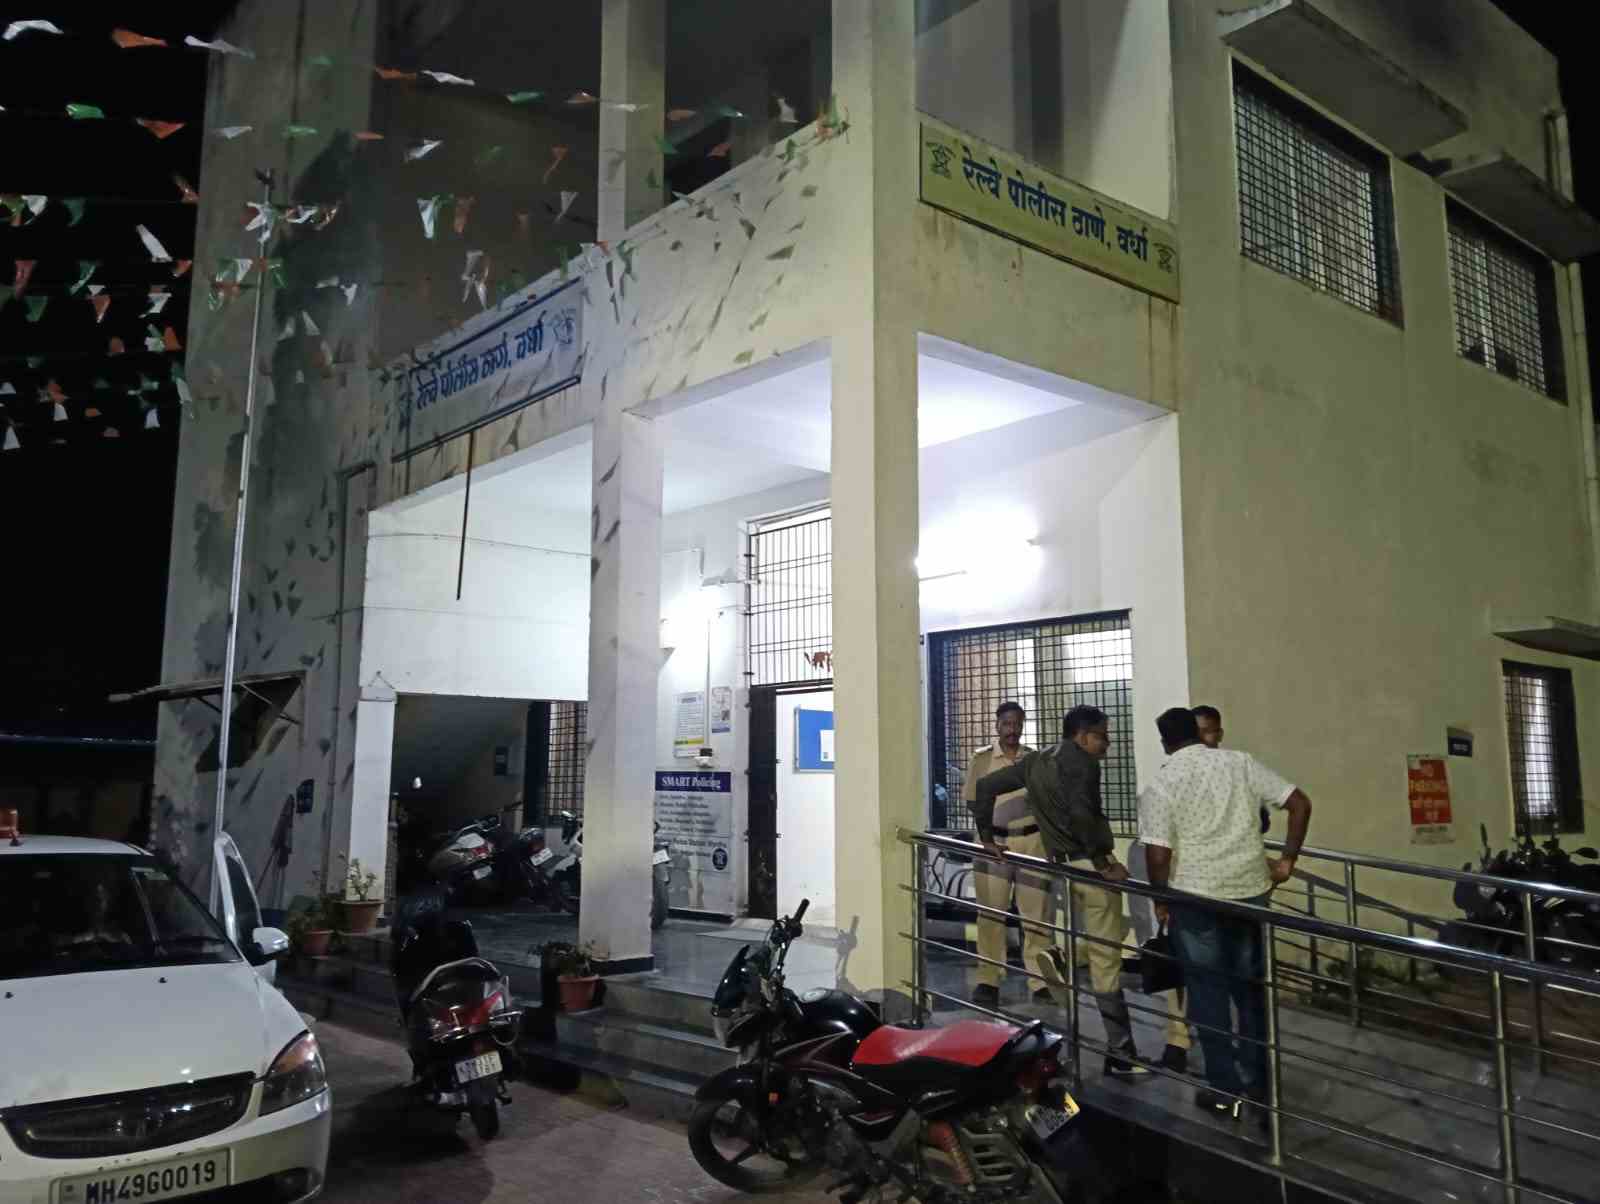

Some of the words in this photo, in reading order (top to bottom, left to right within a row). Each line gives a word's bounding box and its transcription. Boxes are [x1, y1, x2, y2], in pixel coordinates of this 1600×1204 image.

[962, 145, 1001, 198] रेल्वे
[1007, 170, 1067, 227] पोलीस
[1116, 226, 1148, 262] वर्धा
[661, 776, 690, 786] SMART
[86, 1160, 216, 1204] MH49G0019
